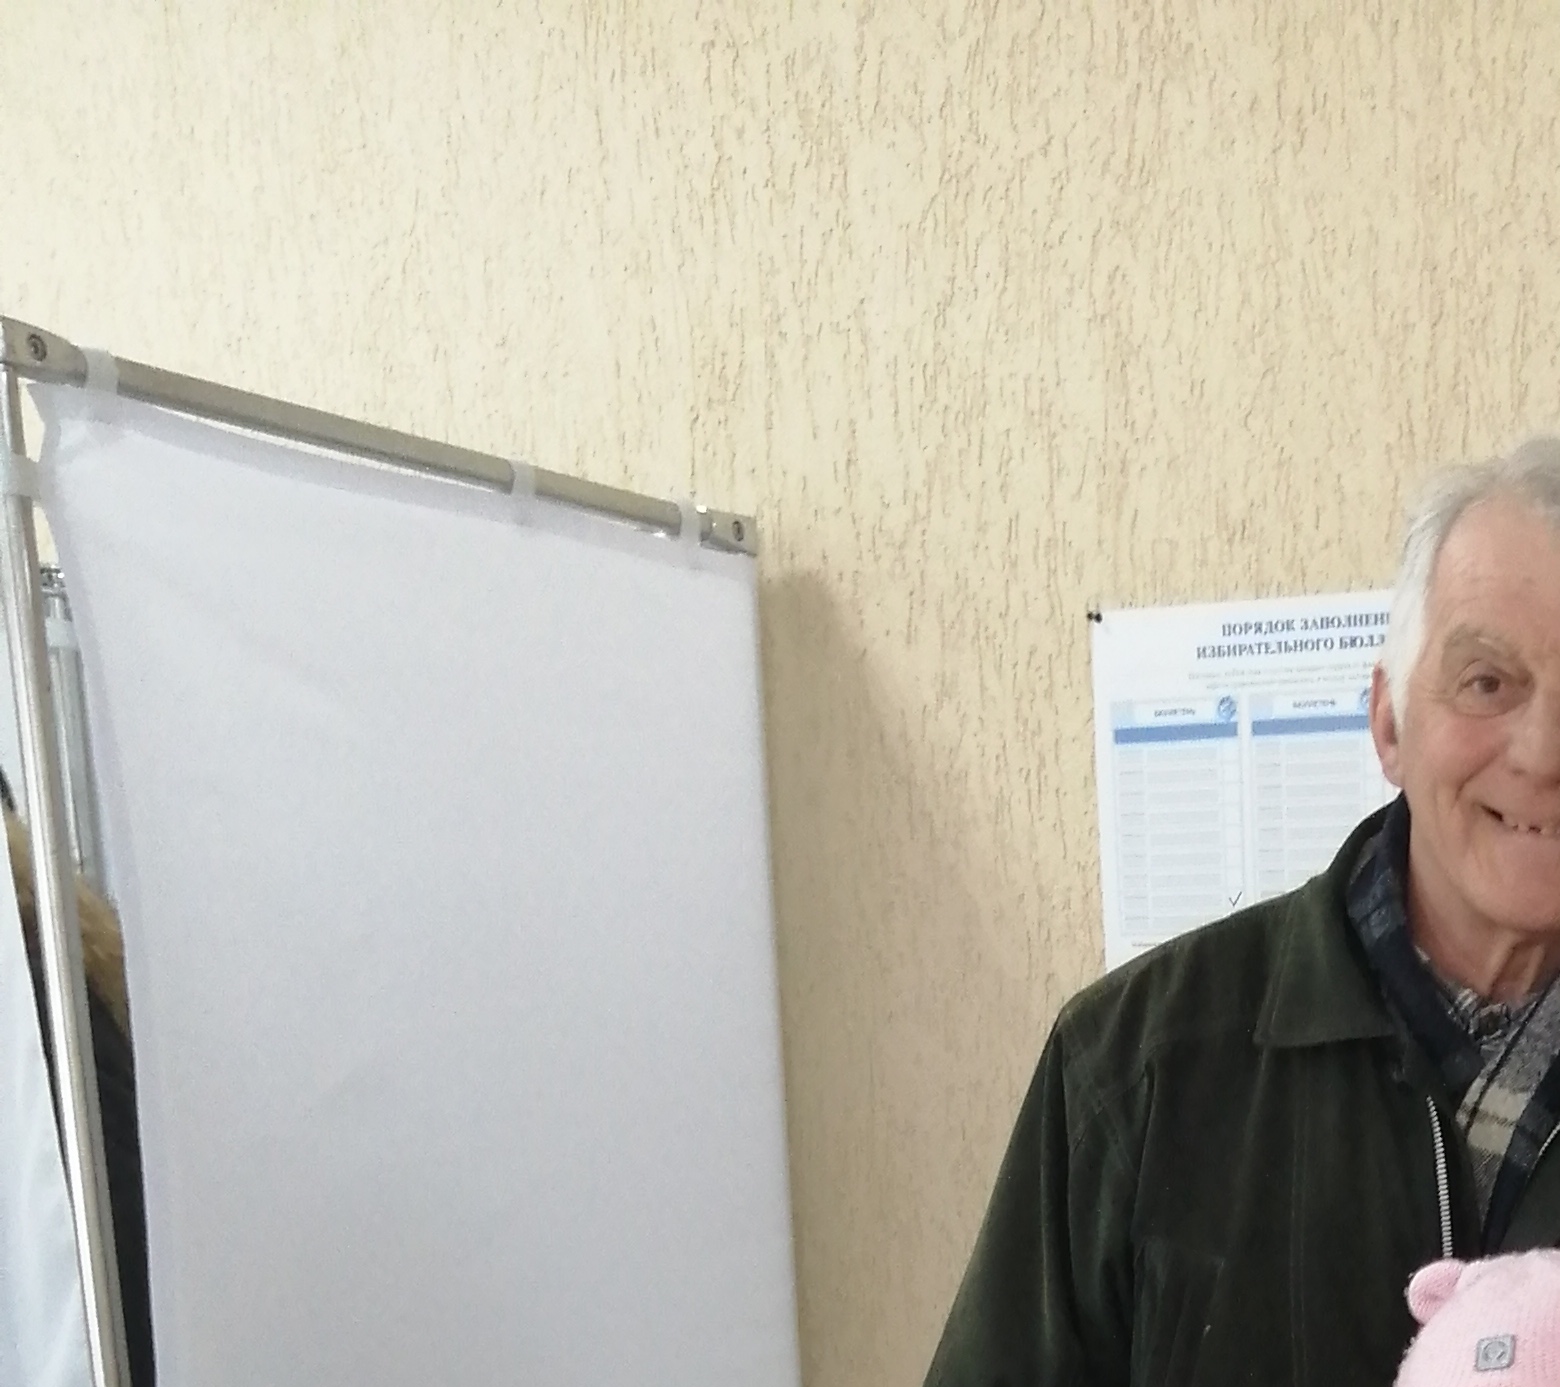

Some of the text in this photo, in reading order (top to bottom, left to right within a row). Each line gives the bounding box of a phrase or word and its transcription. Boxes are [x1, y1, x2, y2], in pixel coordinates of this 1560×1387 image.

[1221, 618, 1295, 637] ПОРЯДОК
[1196, 634, 1385, 660] ИЗБИРАТЕЛЬНОГО БЮЛЛ
